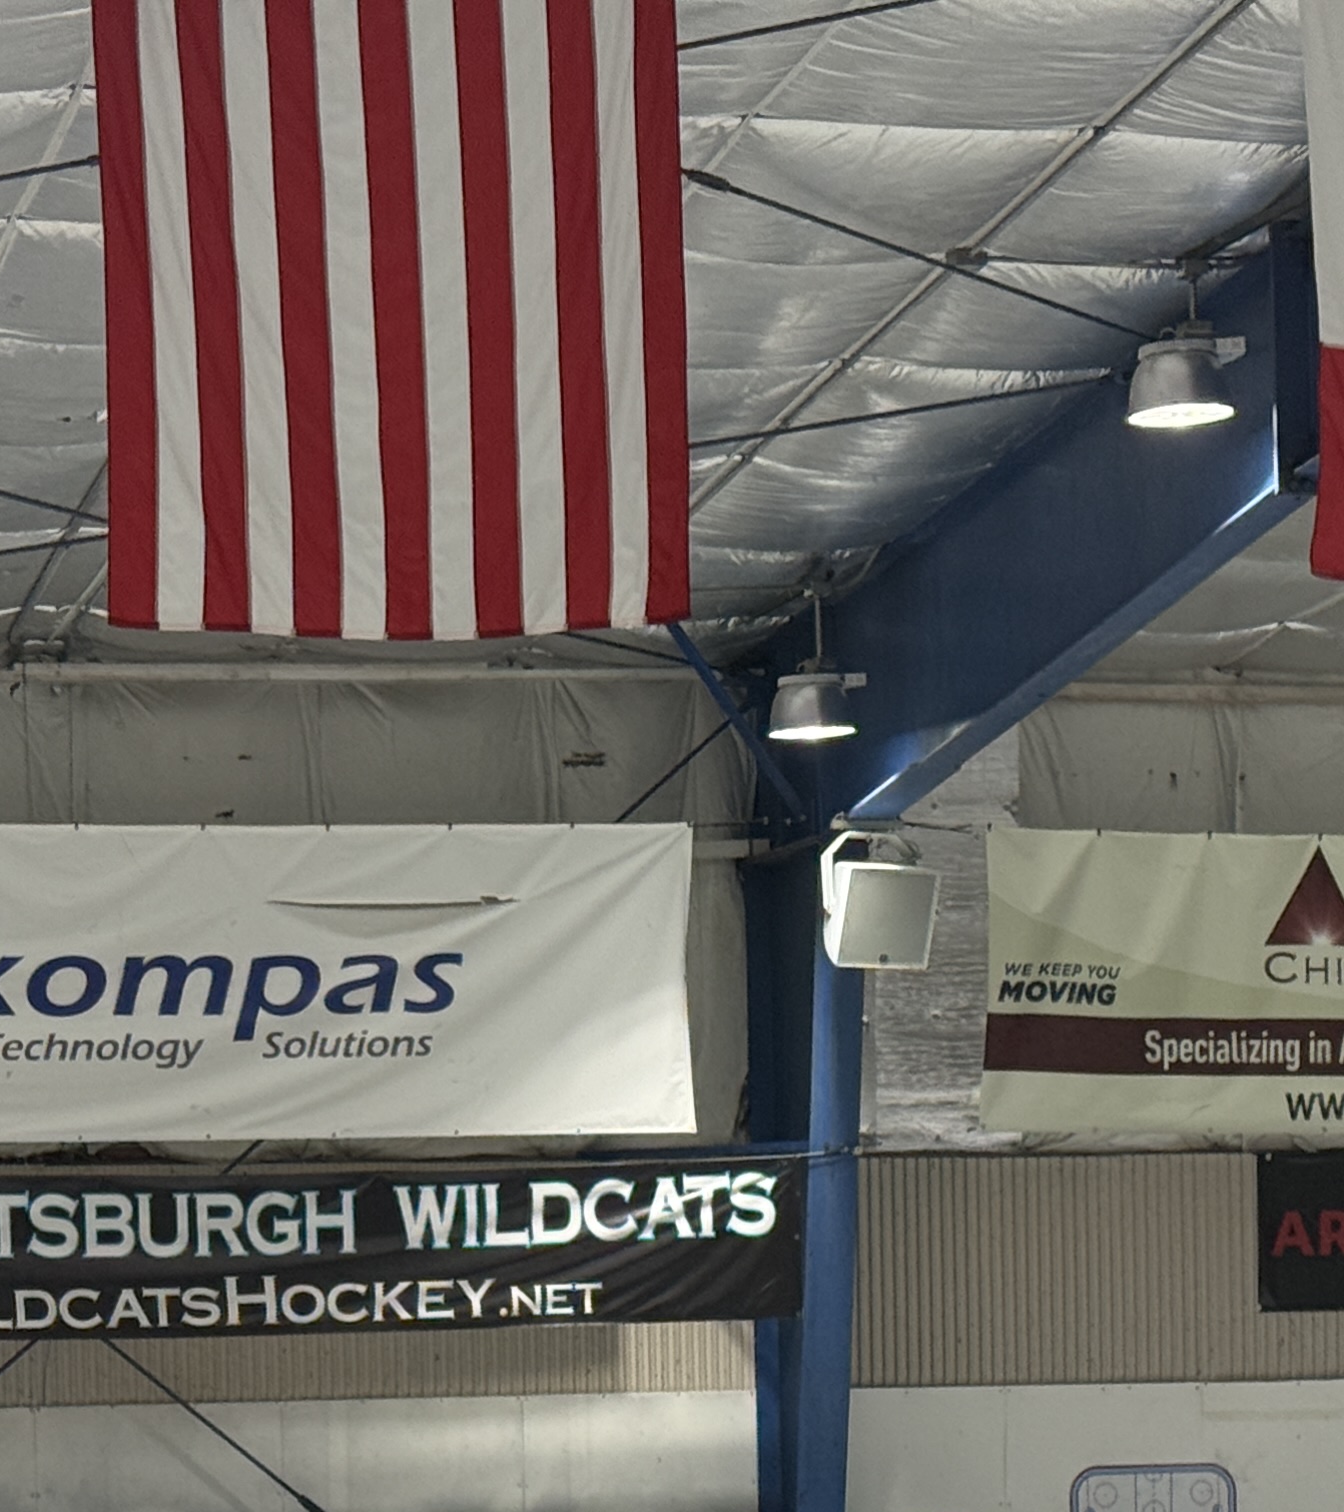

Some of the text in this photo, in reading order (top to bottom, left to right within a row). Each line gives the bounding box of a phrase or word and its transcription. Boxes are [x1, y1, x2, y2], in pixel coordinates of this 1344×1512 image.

[1004, 962, 1121, 981] WE KEEP YOU
[997, 981, 1117, 1005] MOVING
[262, 1029, 432, 1061] Solutions
[1145, 1030, 1300, 1072] Specializing
[1309, 1031, 1332, 1063] in
[393, 1171, 777, 1251] WILDCATS
